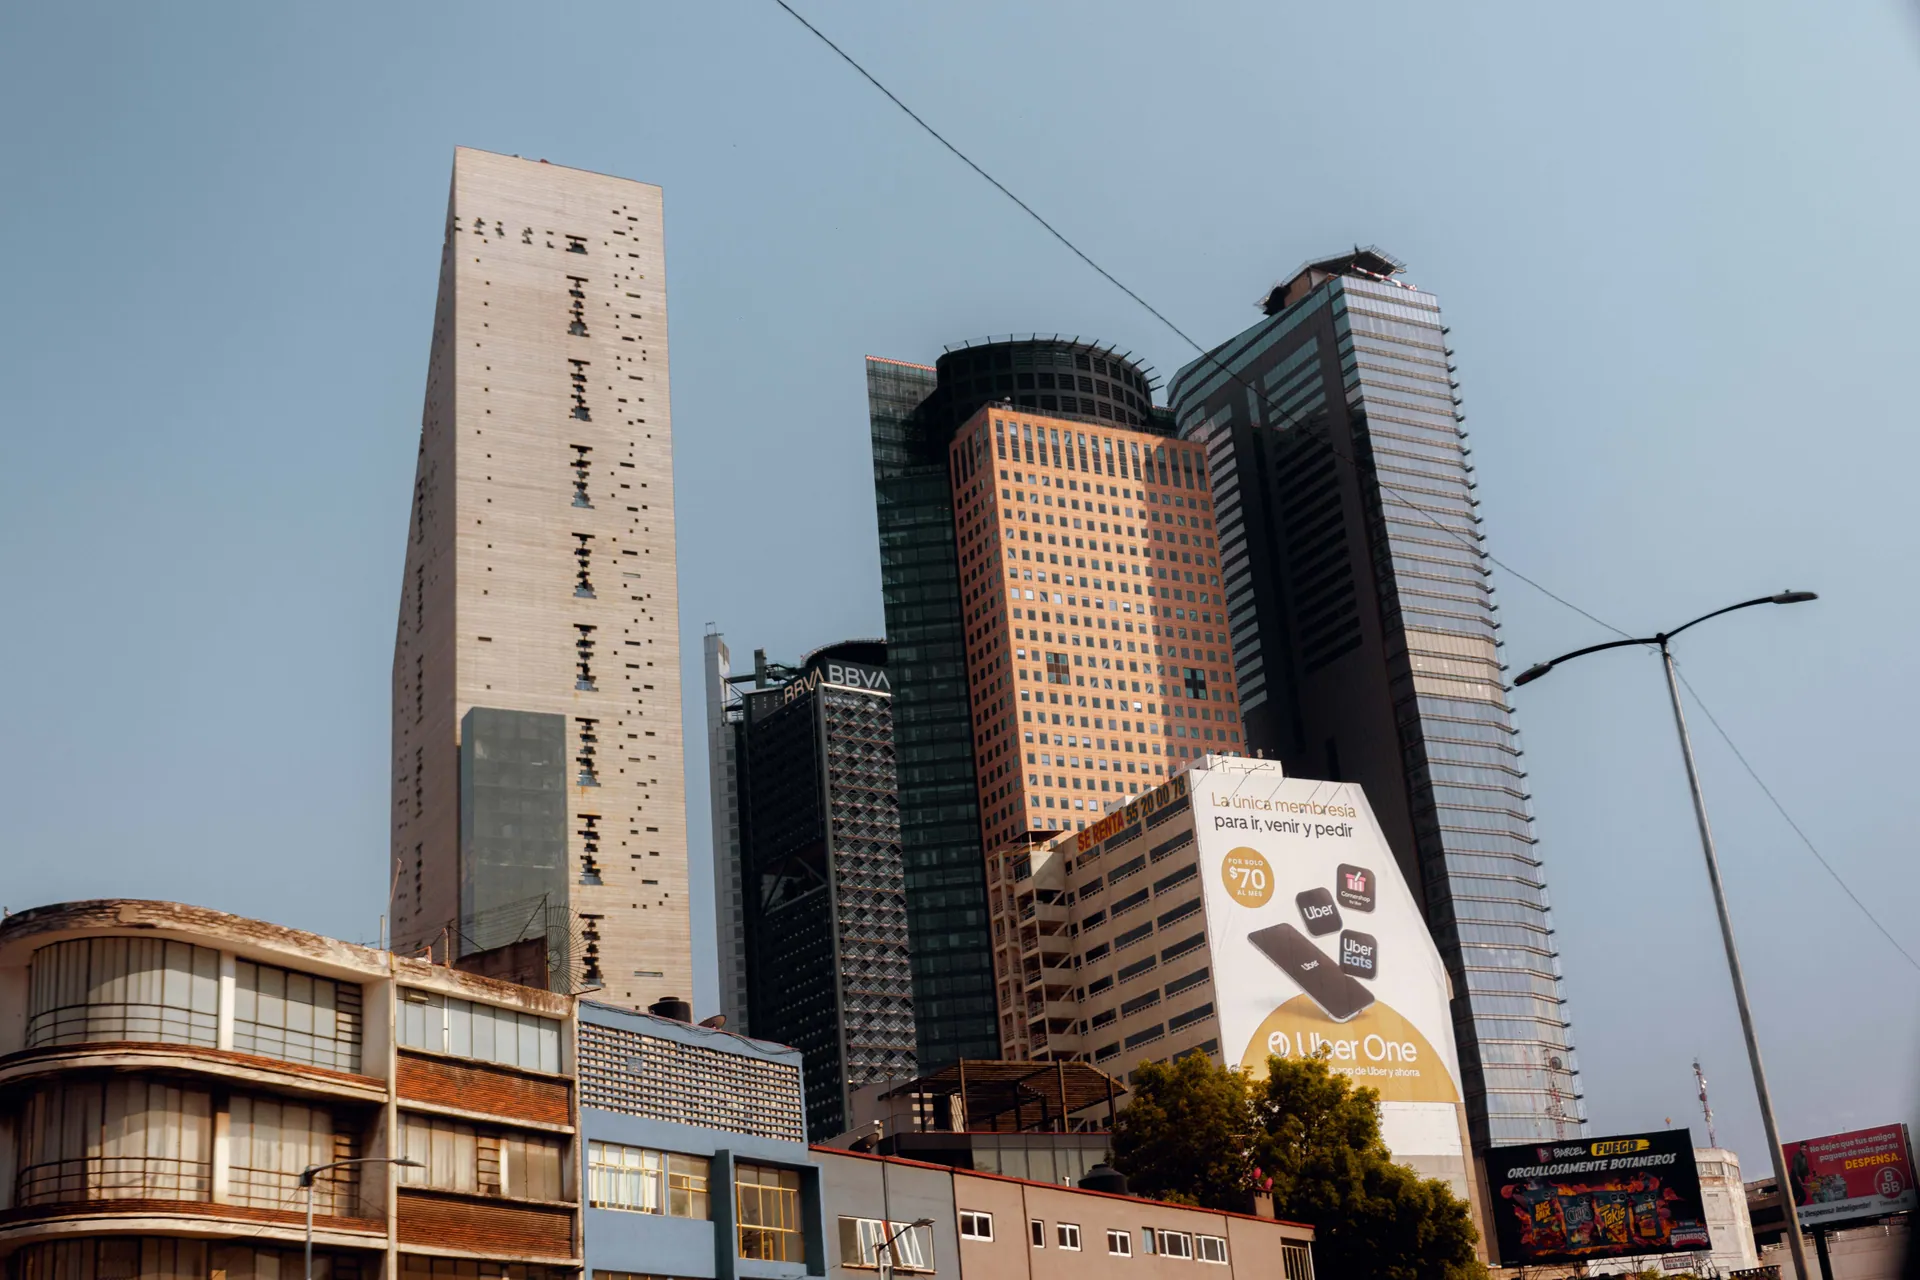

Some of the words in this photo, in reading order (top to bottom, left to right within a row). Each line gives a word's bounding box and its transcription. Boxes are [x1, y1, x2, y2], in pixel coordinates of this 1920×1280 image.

[829, 664, 890, 689] BBVA
[1077, 828, 1091, 852] SE
[1092, 811, 1125, 845] RENTA
[1125, 802, 1138, 825] 55
[1141, 794, 1154, 817] 20
[1171, 775, 1185, 799] 78
[1211, 792, 1230, 807] La
[1233, 794, 1272, 811] única
[1275, 800, 1356, 818] membresía
[1214, 815, 1248, 830] para
[1251, 815, 1263, 832] ir,
[1264, 819, 1300, 833] venir
[1303, 823, 1312, 837] y
[1315, 823, 1353, 838] pedir
[1228, 866, 1265, 889] $70
[1340, 890, 1371, 904] Cornershop
[1303, 904, 1333, 920] Uber
[1343, 938, 1373, 956] Uber
[1300, 960, 1319, 971] Uber
[1343, 951, 1373, 969] Eats
[1296, 1032, 1359, 1061] Uber
[1364, 1033, 1417, 1062] One
[1355, 1066, 1366, 1075] de
[1367, 1066, 1387, 1076] Uber
[1389, 1068, 1394, 1078] y
[1595, 1140, 1639, 1155] FUEGO
[1809, 1145, 1820, 1153] No
[1820, 1143, 1840, 1152] dejes
[1840, 1140, 1854, 1149] que
[1868, 1132, 1896, 1142] amigos
[1553, 1146, 1586, 1158] BARCEL
[1819, 1152, 1847, 1163] paguen
[1857, 1146, 1873, 1154] más
[1875, 1145, 1888, 1154] por
[1845, 1152, 1902, 1170] DESPENSA.
[1507, 1160, 1608, 1179] ORGULLOSAMENTE
[1610, 1152, 1677, 1169] BOTANEROS
[1884, 1170, 1893, 1182] B
[1881, 1180, 1900, 1194] BB
[1535, 1200, 1550, 1212] BIG
[1804, 1207, 1834, 1217] Despensa
[1601, 1206, 1626, 1228] Takis
[1670, 1232, 1708, 1246] BOTANEROS
